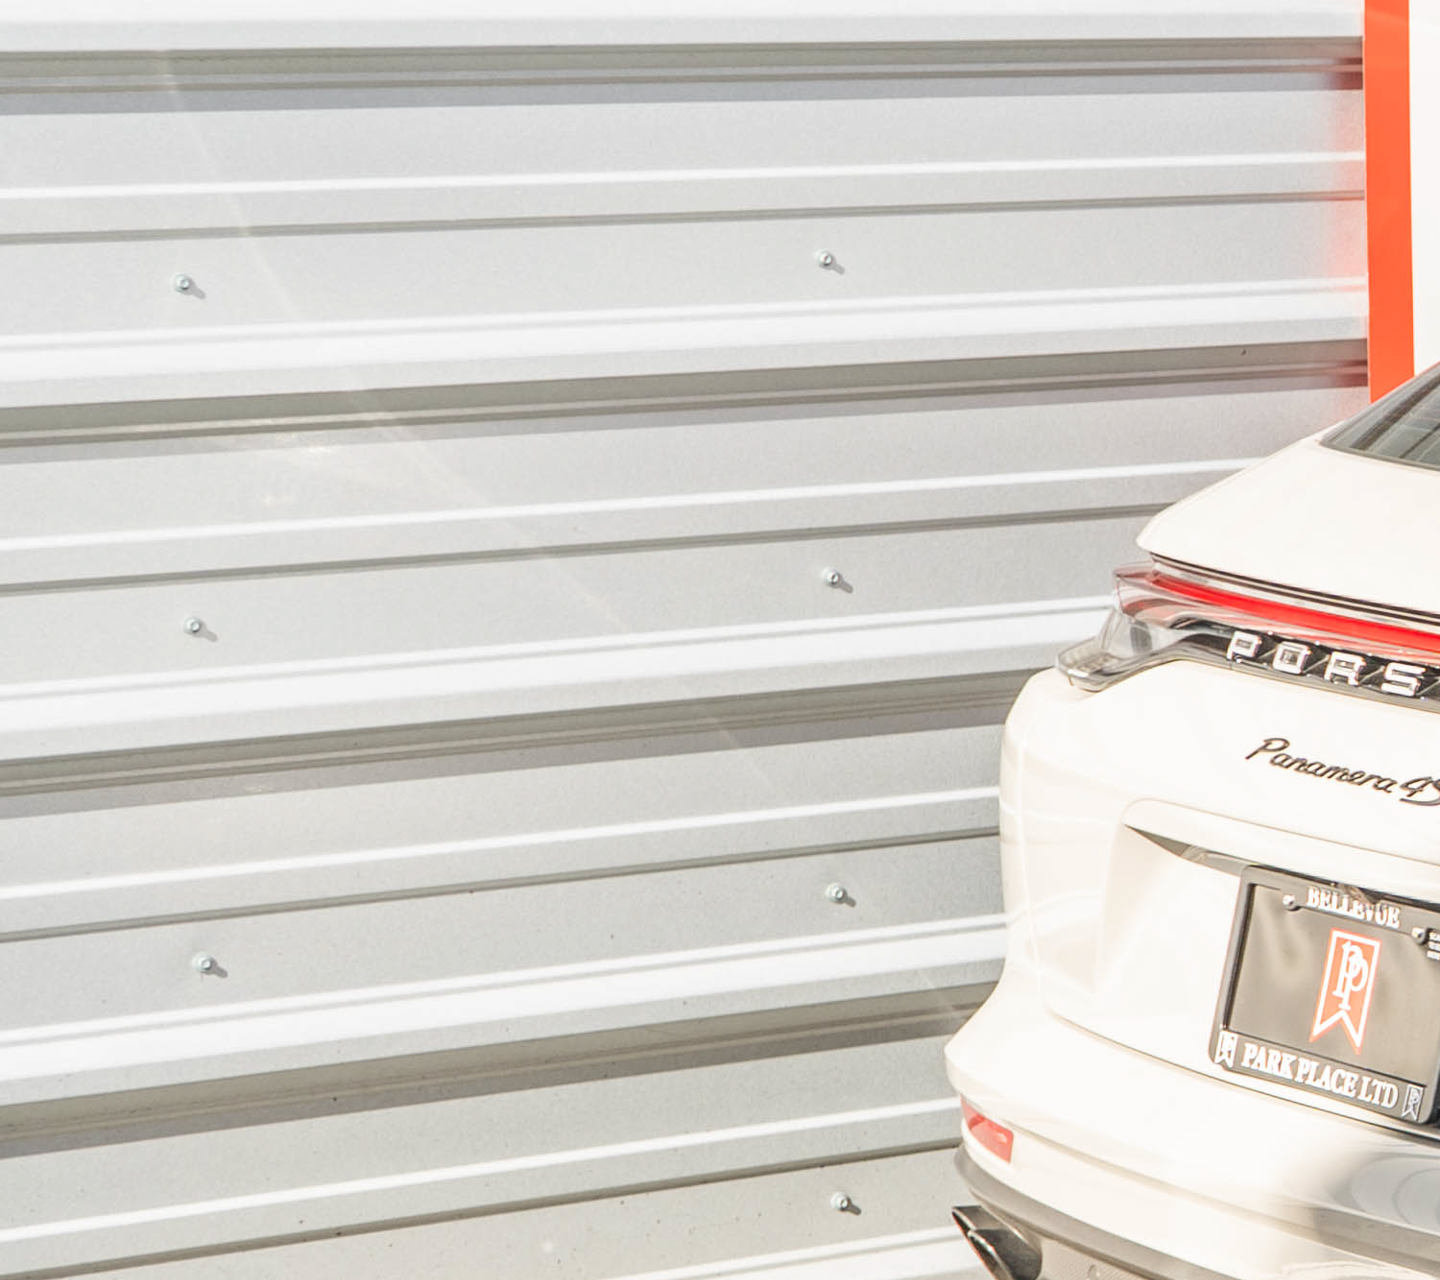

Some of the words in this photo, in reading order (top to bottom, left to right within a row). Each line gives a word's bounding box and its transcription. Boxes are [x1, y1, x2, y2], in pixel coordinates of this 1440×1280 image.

[1244, 737, 1400, 793] Panamera
[1306, 887, 1401, 928] BELLEVUE
[1240, 1042, 1300, 1075] PARK
[1295, 1056, 1356, 1098] PLACE
[1360, 1081, 1399, 1109] LTD
